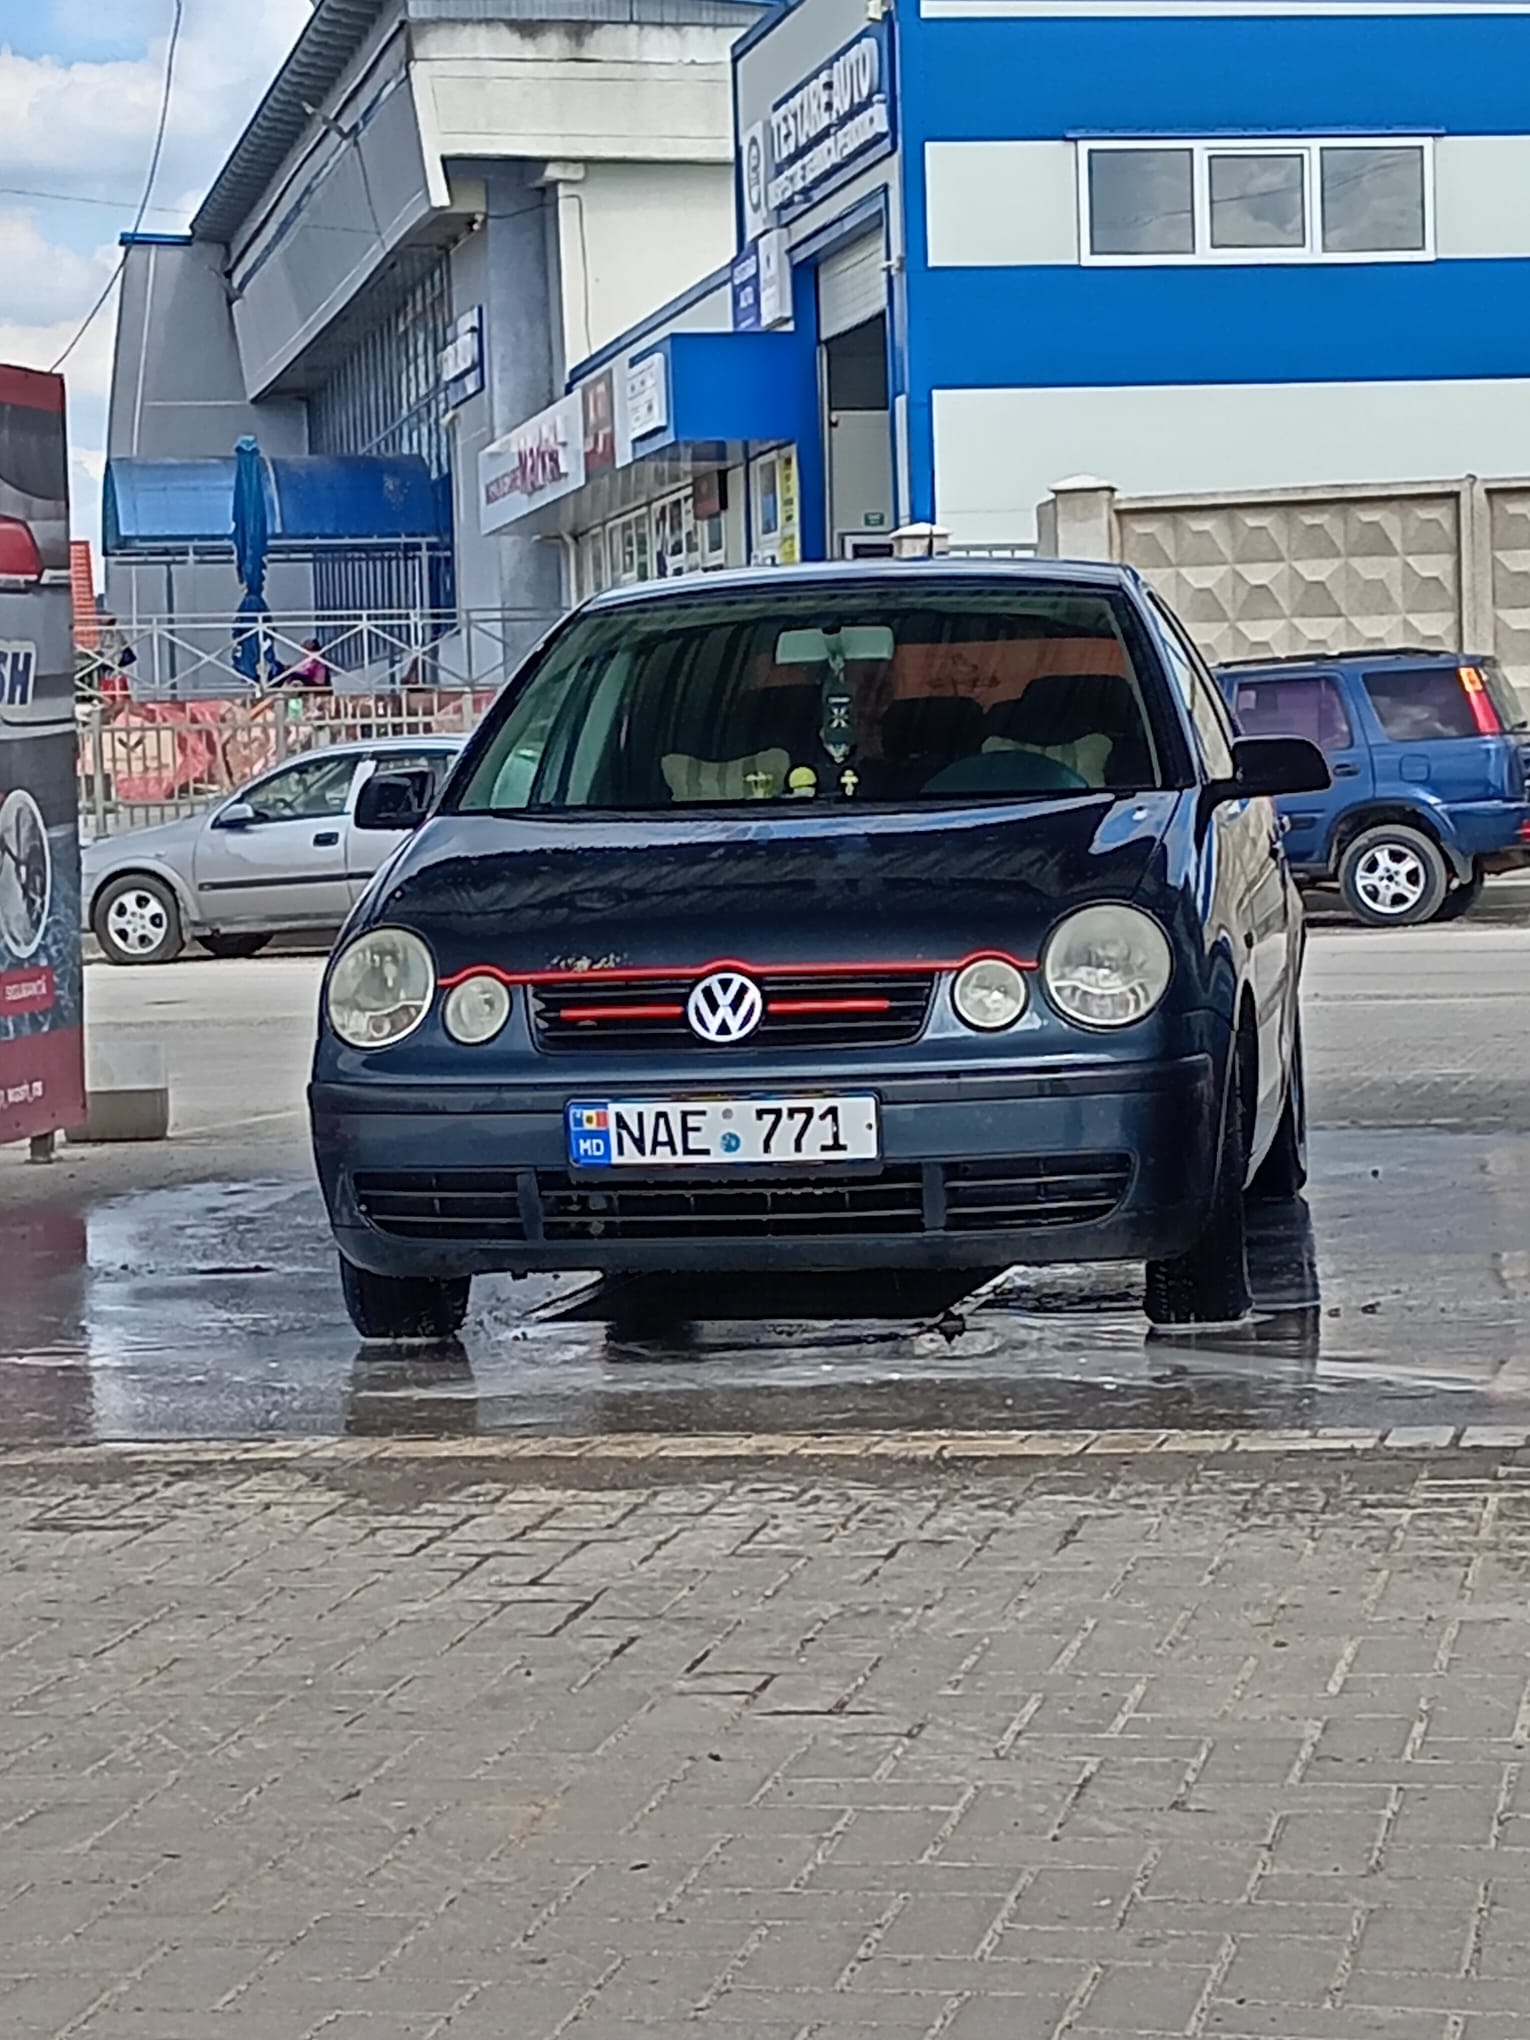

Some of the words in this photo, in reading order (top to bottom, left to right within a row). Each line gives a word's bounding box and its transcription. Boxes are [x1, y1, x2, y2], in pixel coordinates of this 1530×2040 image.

[771, 68, 834, 163] TESTARE
[832, 37, 879, 122] AUTO
[578, 1138, 605, 1157] MD
[614, 1109, 711, 1157] NAE
[755, 1105, 848, 1155] 771
